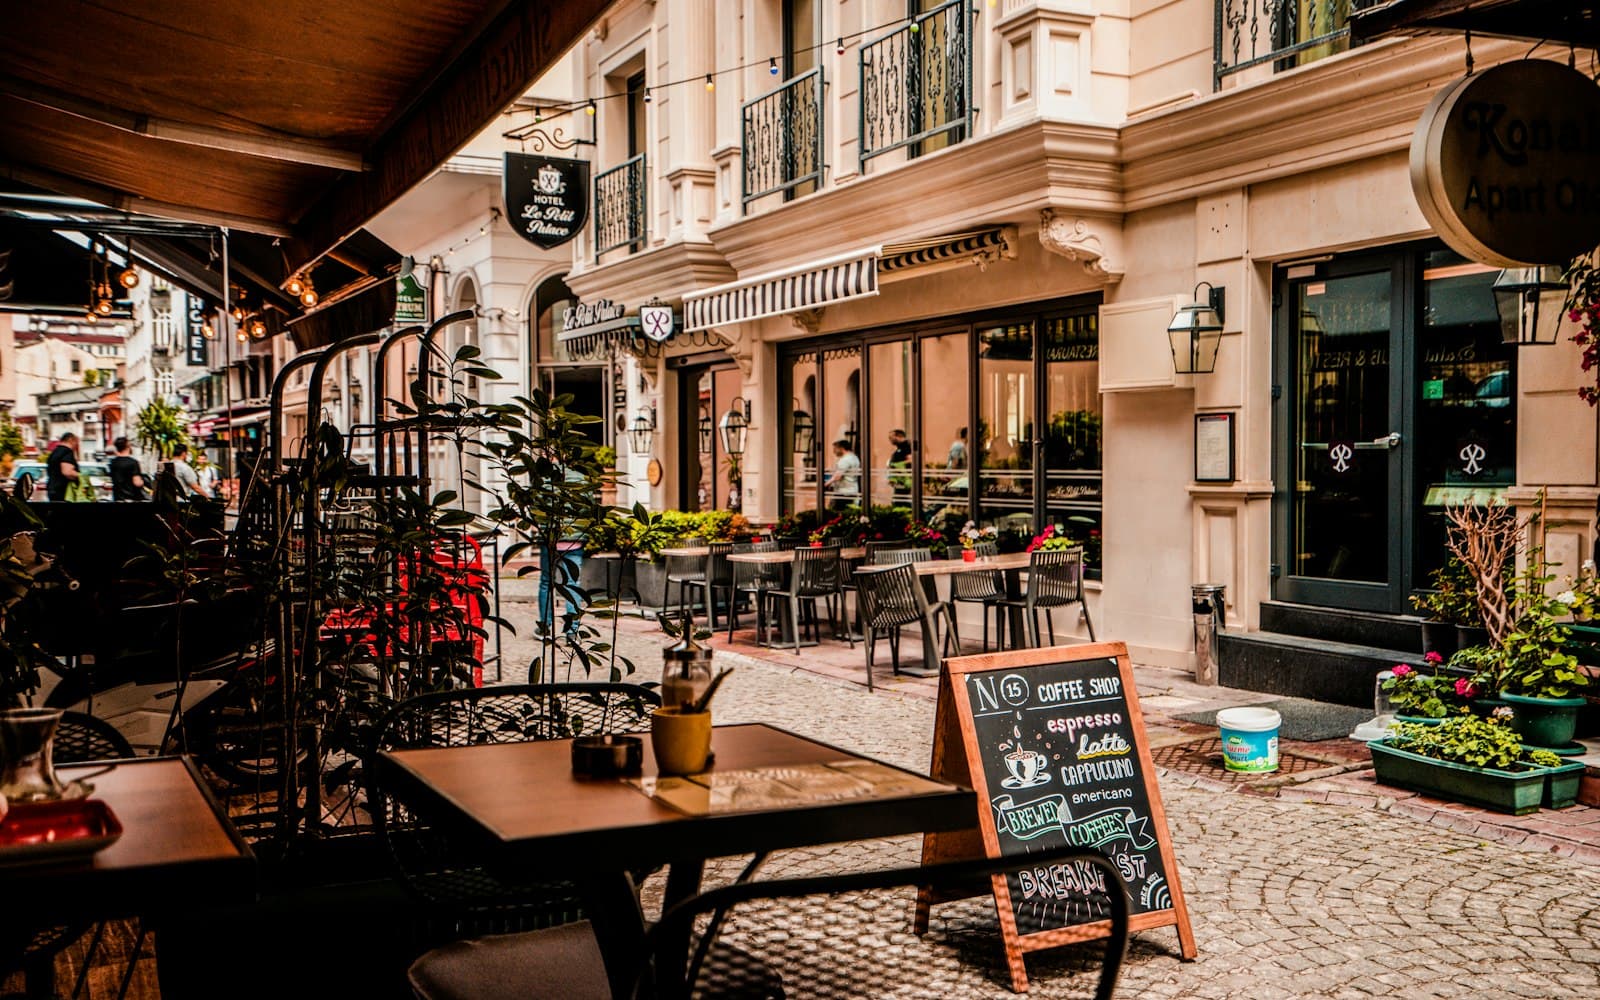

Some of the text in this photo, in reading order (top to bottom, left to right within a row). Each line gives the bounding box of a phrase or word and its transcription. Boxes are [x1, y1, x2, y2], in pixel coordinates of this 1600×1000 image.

[533, 195, 565, 206] HOTEL
[1464, 175, 1546, 221] Apart
[1556, 176, 1600, 214] Ote
[521, 204, 575, 222] Le Petit
[526, 219, 569, 236] Palace
[1005, 682, 1022, 698] 15
[1037, 676, 1120, 703] COFFEE SHOP
[1047, 712, 1122, 743] espresso
[1076, 733, 1131, 756] latte
[1060, 758, 1134, 786] CAPPUCCINO
[1072, 788, 1133, 804] americano
[1007, 800, 1060, 833] BREWED
[1069, 812, 1126, 846] COFFEES
